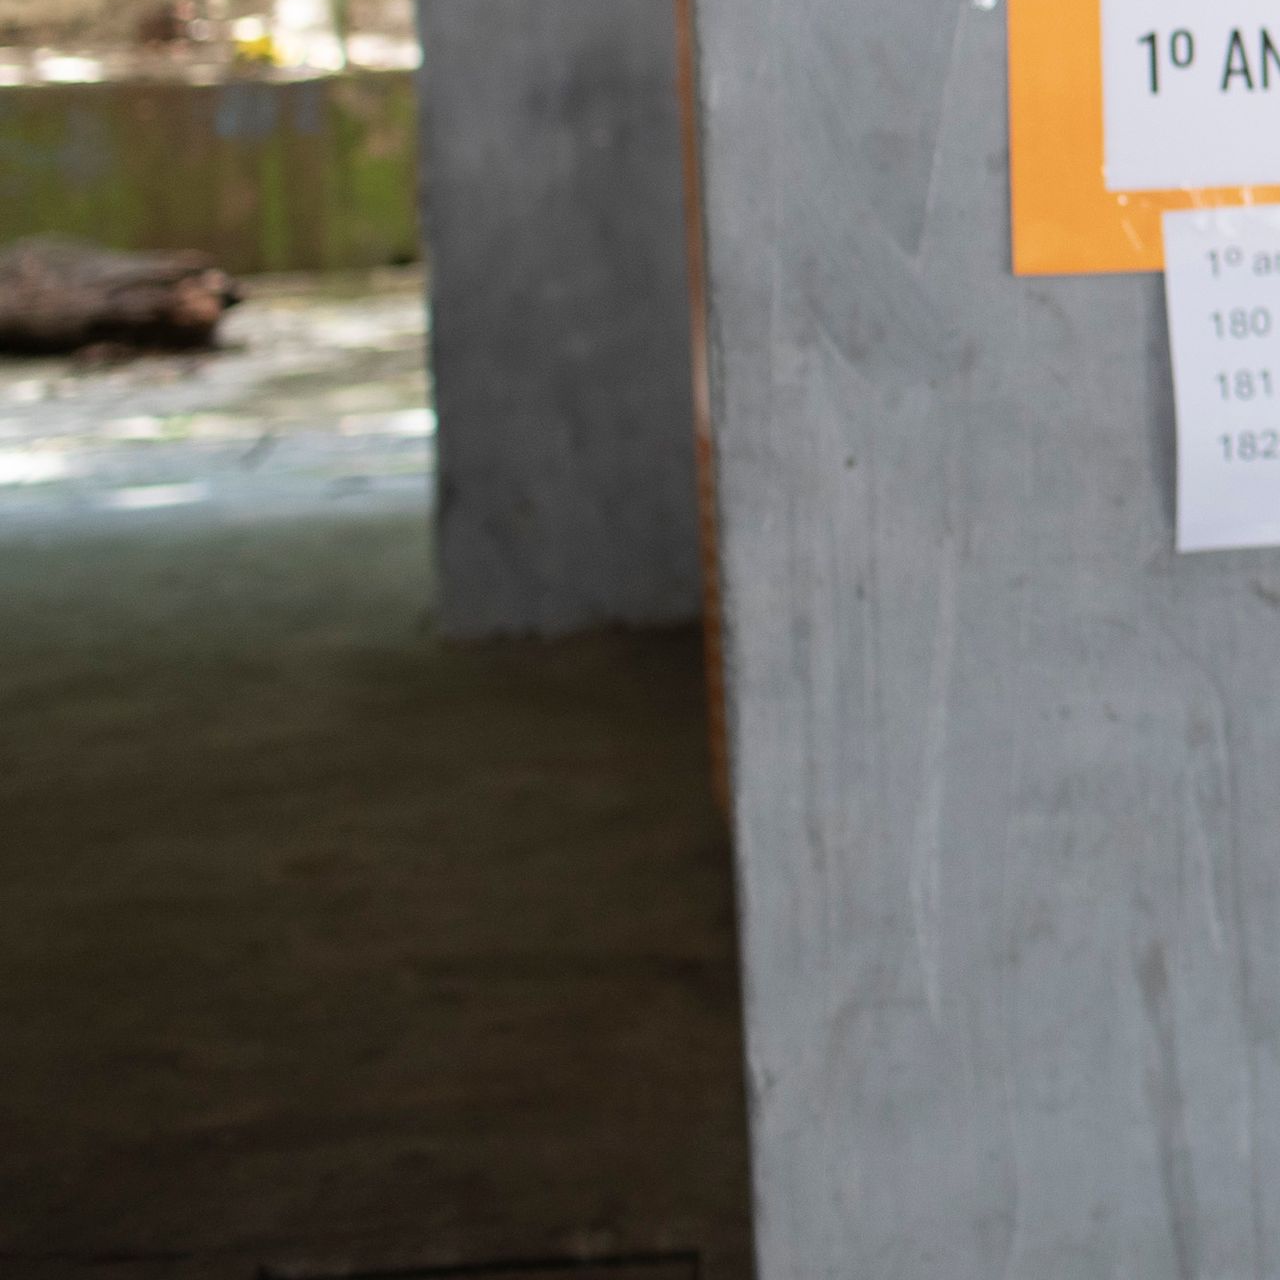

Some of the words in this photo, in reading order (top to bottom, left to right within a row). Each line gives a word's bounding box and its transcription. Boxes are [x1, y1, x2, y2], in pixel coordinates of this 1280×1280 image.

[1138, 29, 1195, 96] 1º
[1210, 306, 1272, 339] 180
[1215, 368, 1275, 401] 181
[1218, 430, 1280, 463] 182
